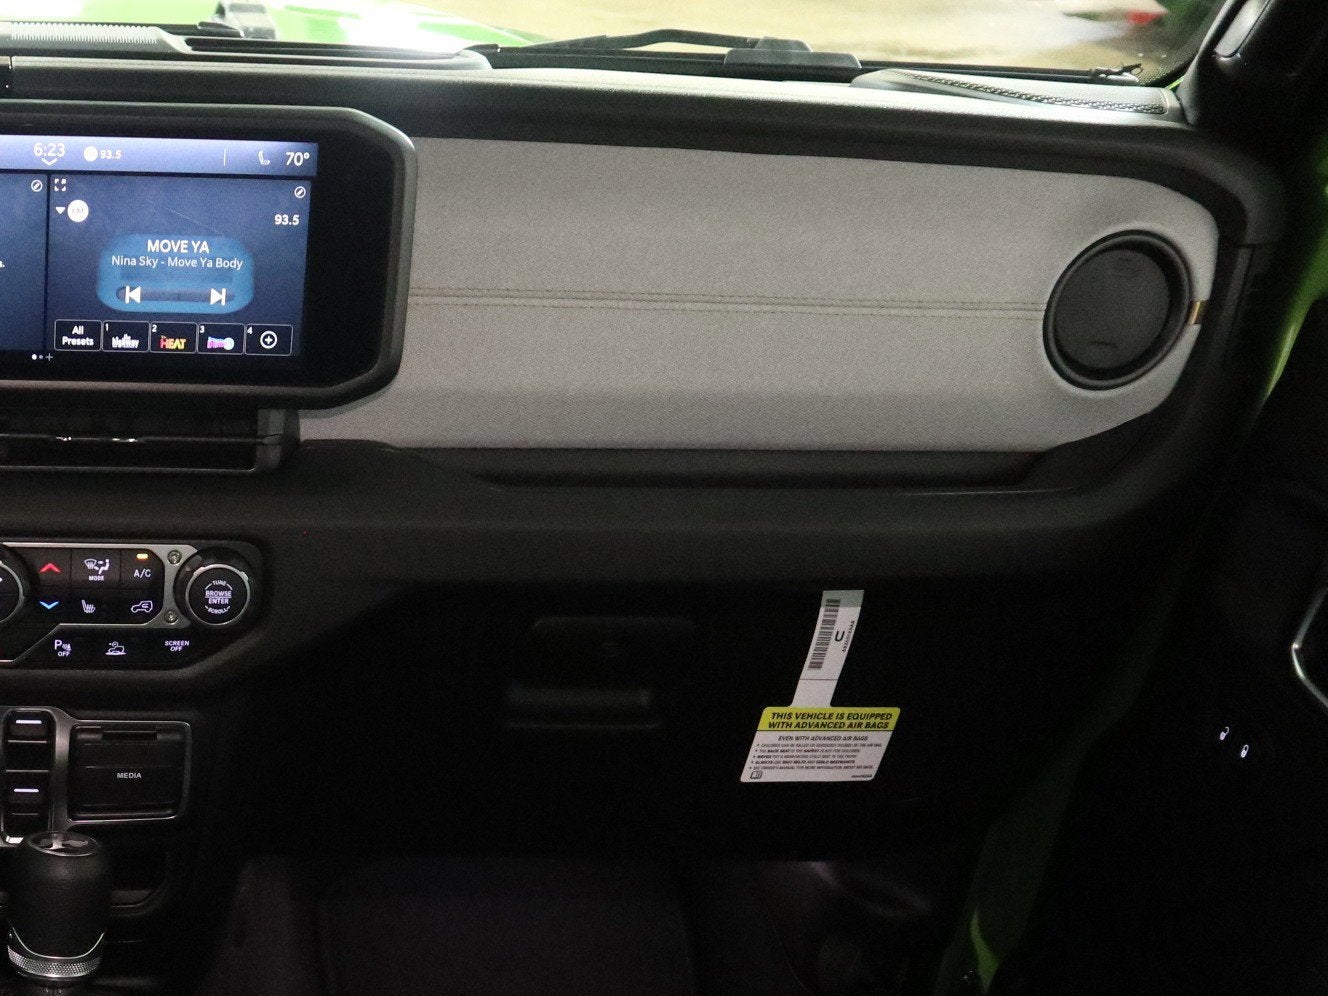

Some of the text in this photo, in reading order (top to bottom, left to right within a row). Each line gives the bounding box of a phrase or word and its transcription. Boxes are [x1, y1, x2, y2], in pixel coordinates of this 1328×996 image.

[33, 143, 66, 157] 6:23
[100, 149, 122, 160] 93.5
[285, 151, 310, 166] 70°
[274, 213, 300, 226] 93.5
[147, 239, 210, 254] MOVE YA
[111, 255, 137, 266] Nina
[139, 256, 159, 269] Sky
[167, 256, 198, 268] Move
[200, 257, 213, 268] Ya
[215, 257, 243, 271] Body
[72, 325, 84, 335] All
[152, 324, 157, 332] 2
[200, 325, 205, 334] 3
[247, 326, 253, 335] 4
[62, 336, 94, 346] Presets
[160, 337, 186, 349] HEAT
[133, 568, 152, 578] A/C
[834, 630, 845, 642] U
[771, 712, 892, 720] THIS VEHICLE IS EQUIPPED
